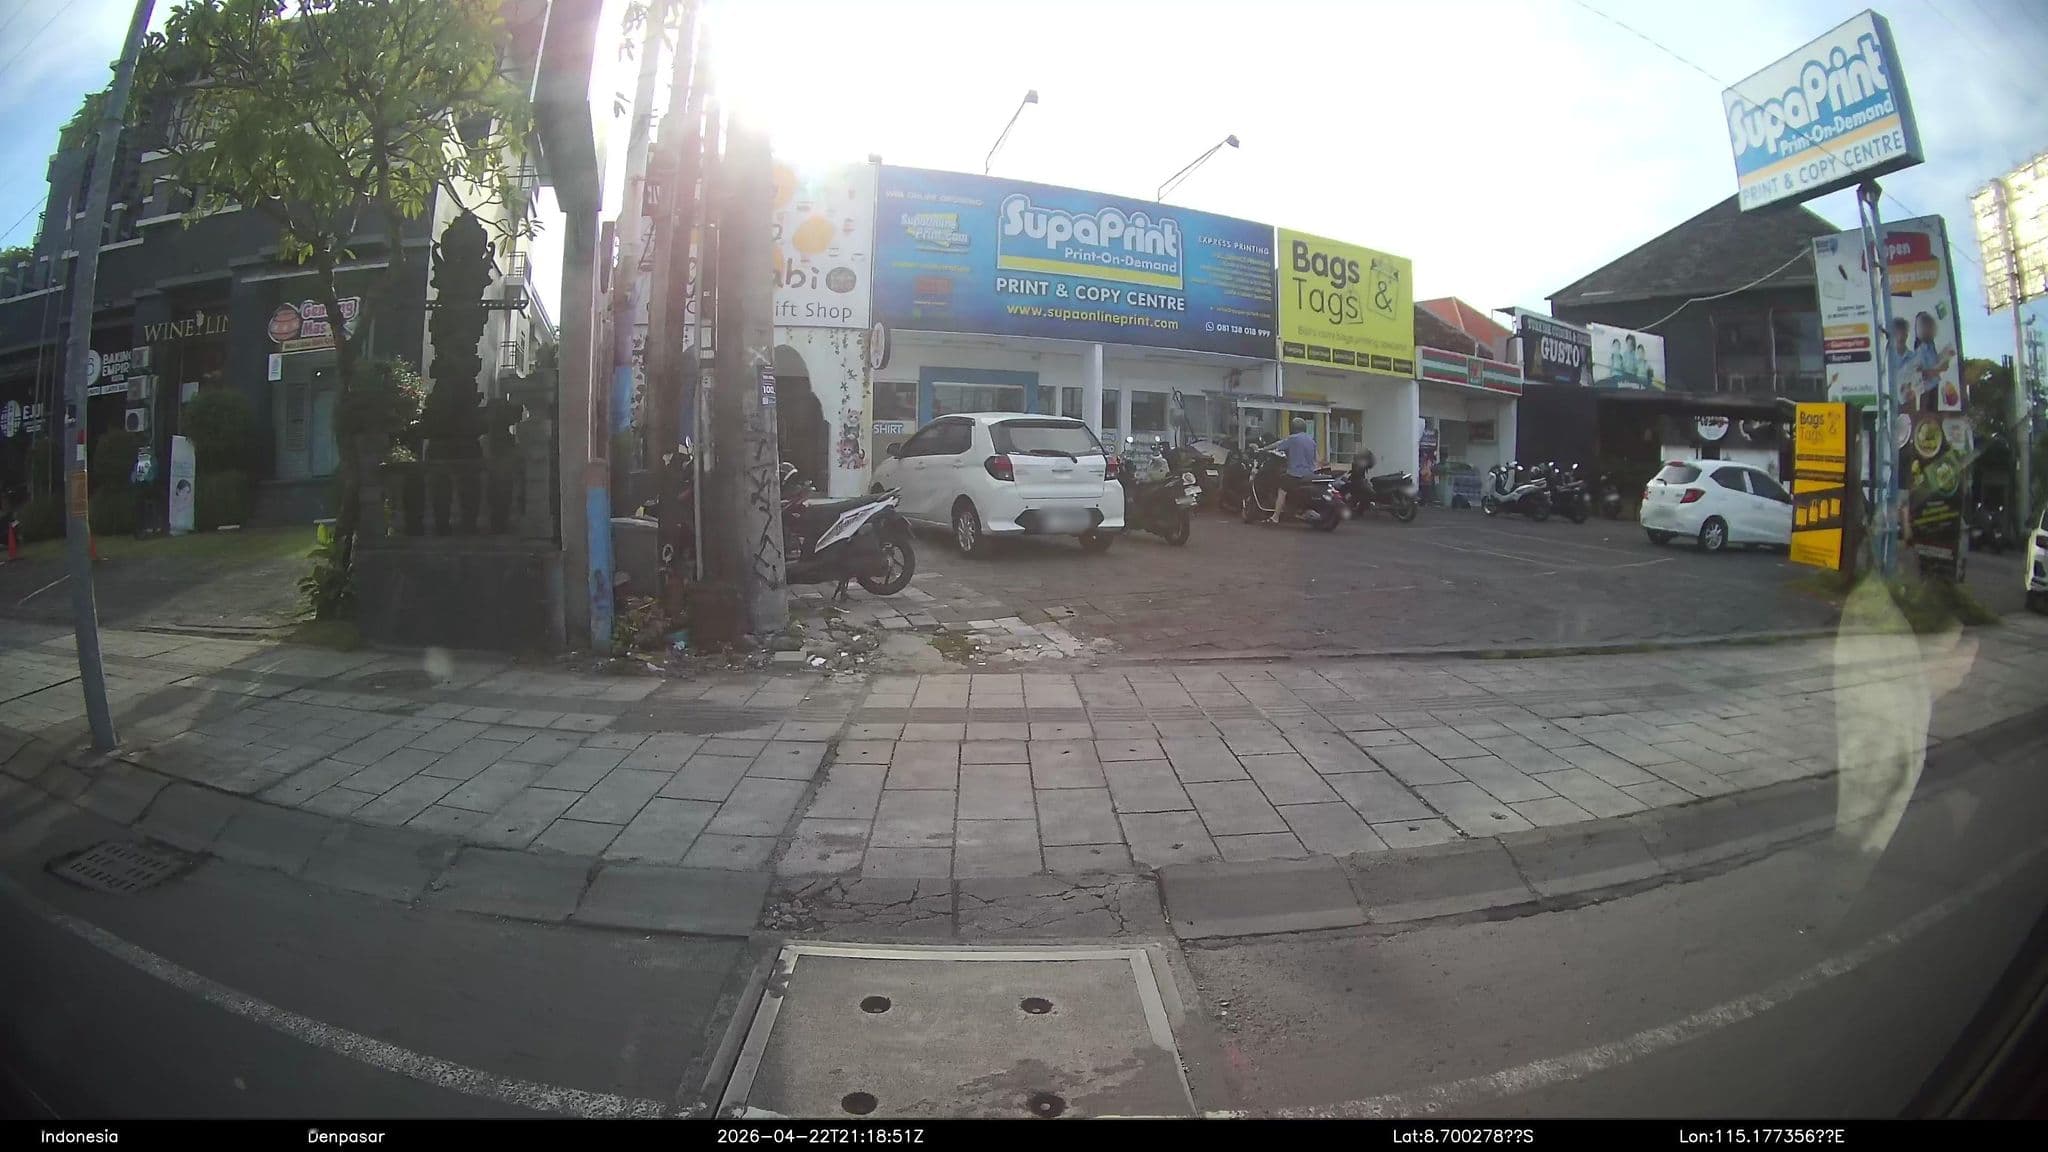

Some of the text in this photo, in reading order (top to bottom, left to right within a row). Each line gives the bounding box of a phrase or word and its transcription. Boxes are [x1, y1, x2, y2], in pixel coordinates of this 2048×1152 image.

[1729, 37, 1888, 155] SupaPrint
[1781, 93, 1895, 156] Print-On-Demand
[1743, 130, 1904, 204] PRINT & COPY CENTRE
[1004, 199, 1177, 258] SupaPrint
[1199, 236, 1270, 255] EXPRESS PRINTING
[1886, 242, 1911, 260] pen
[1064, 247, 1177, 273] Print-On-Demand
[1292, 239, 1360, 289] Bags
[996, 278, 1185, 311] PRINT & COPY CENTRE
[1292, 277, 1393, 325] Tags &
[775, 301, 852, 322] ift Shop
[1007, 305, 1179, 330] www.supaonlineprint.com
[144, 319, 195, 342] WINE
[1540, 336, 1581, 367] GUSTO
[102, 362, 129, 376] EMPIR
[873, 424, 903, 435] SHIRT
[1800, 411, 1824, 427] Bags
[1800, 427, 1824, 444] Tags
